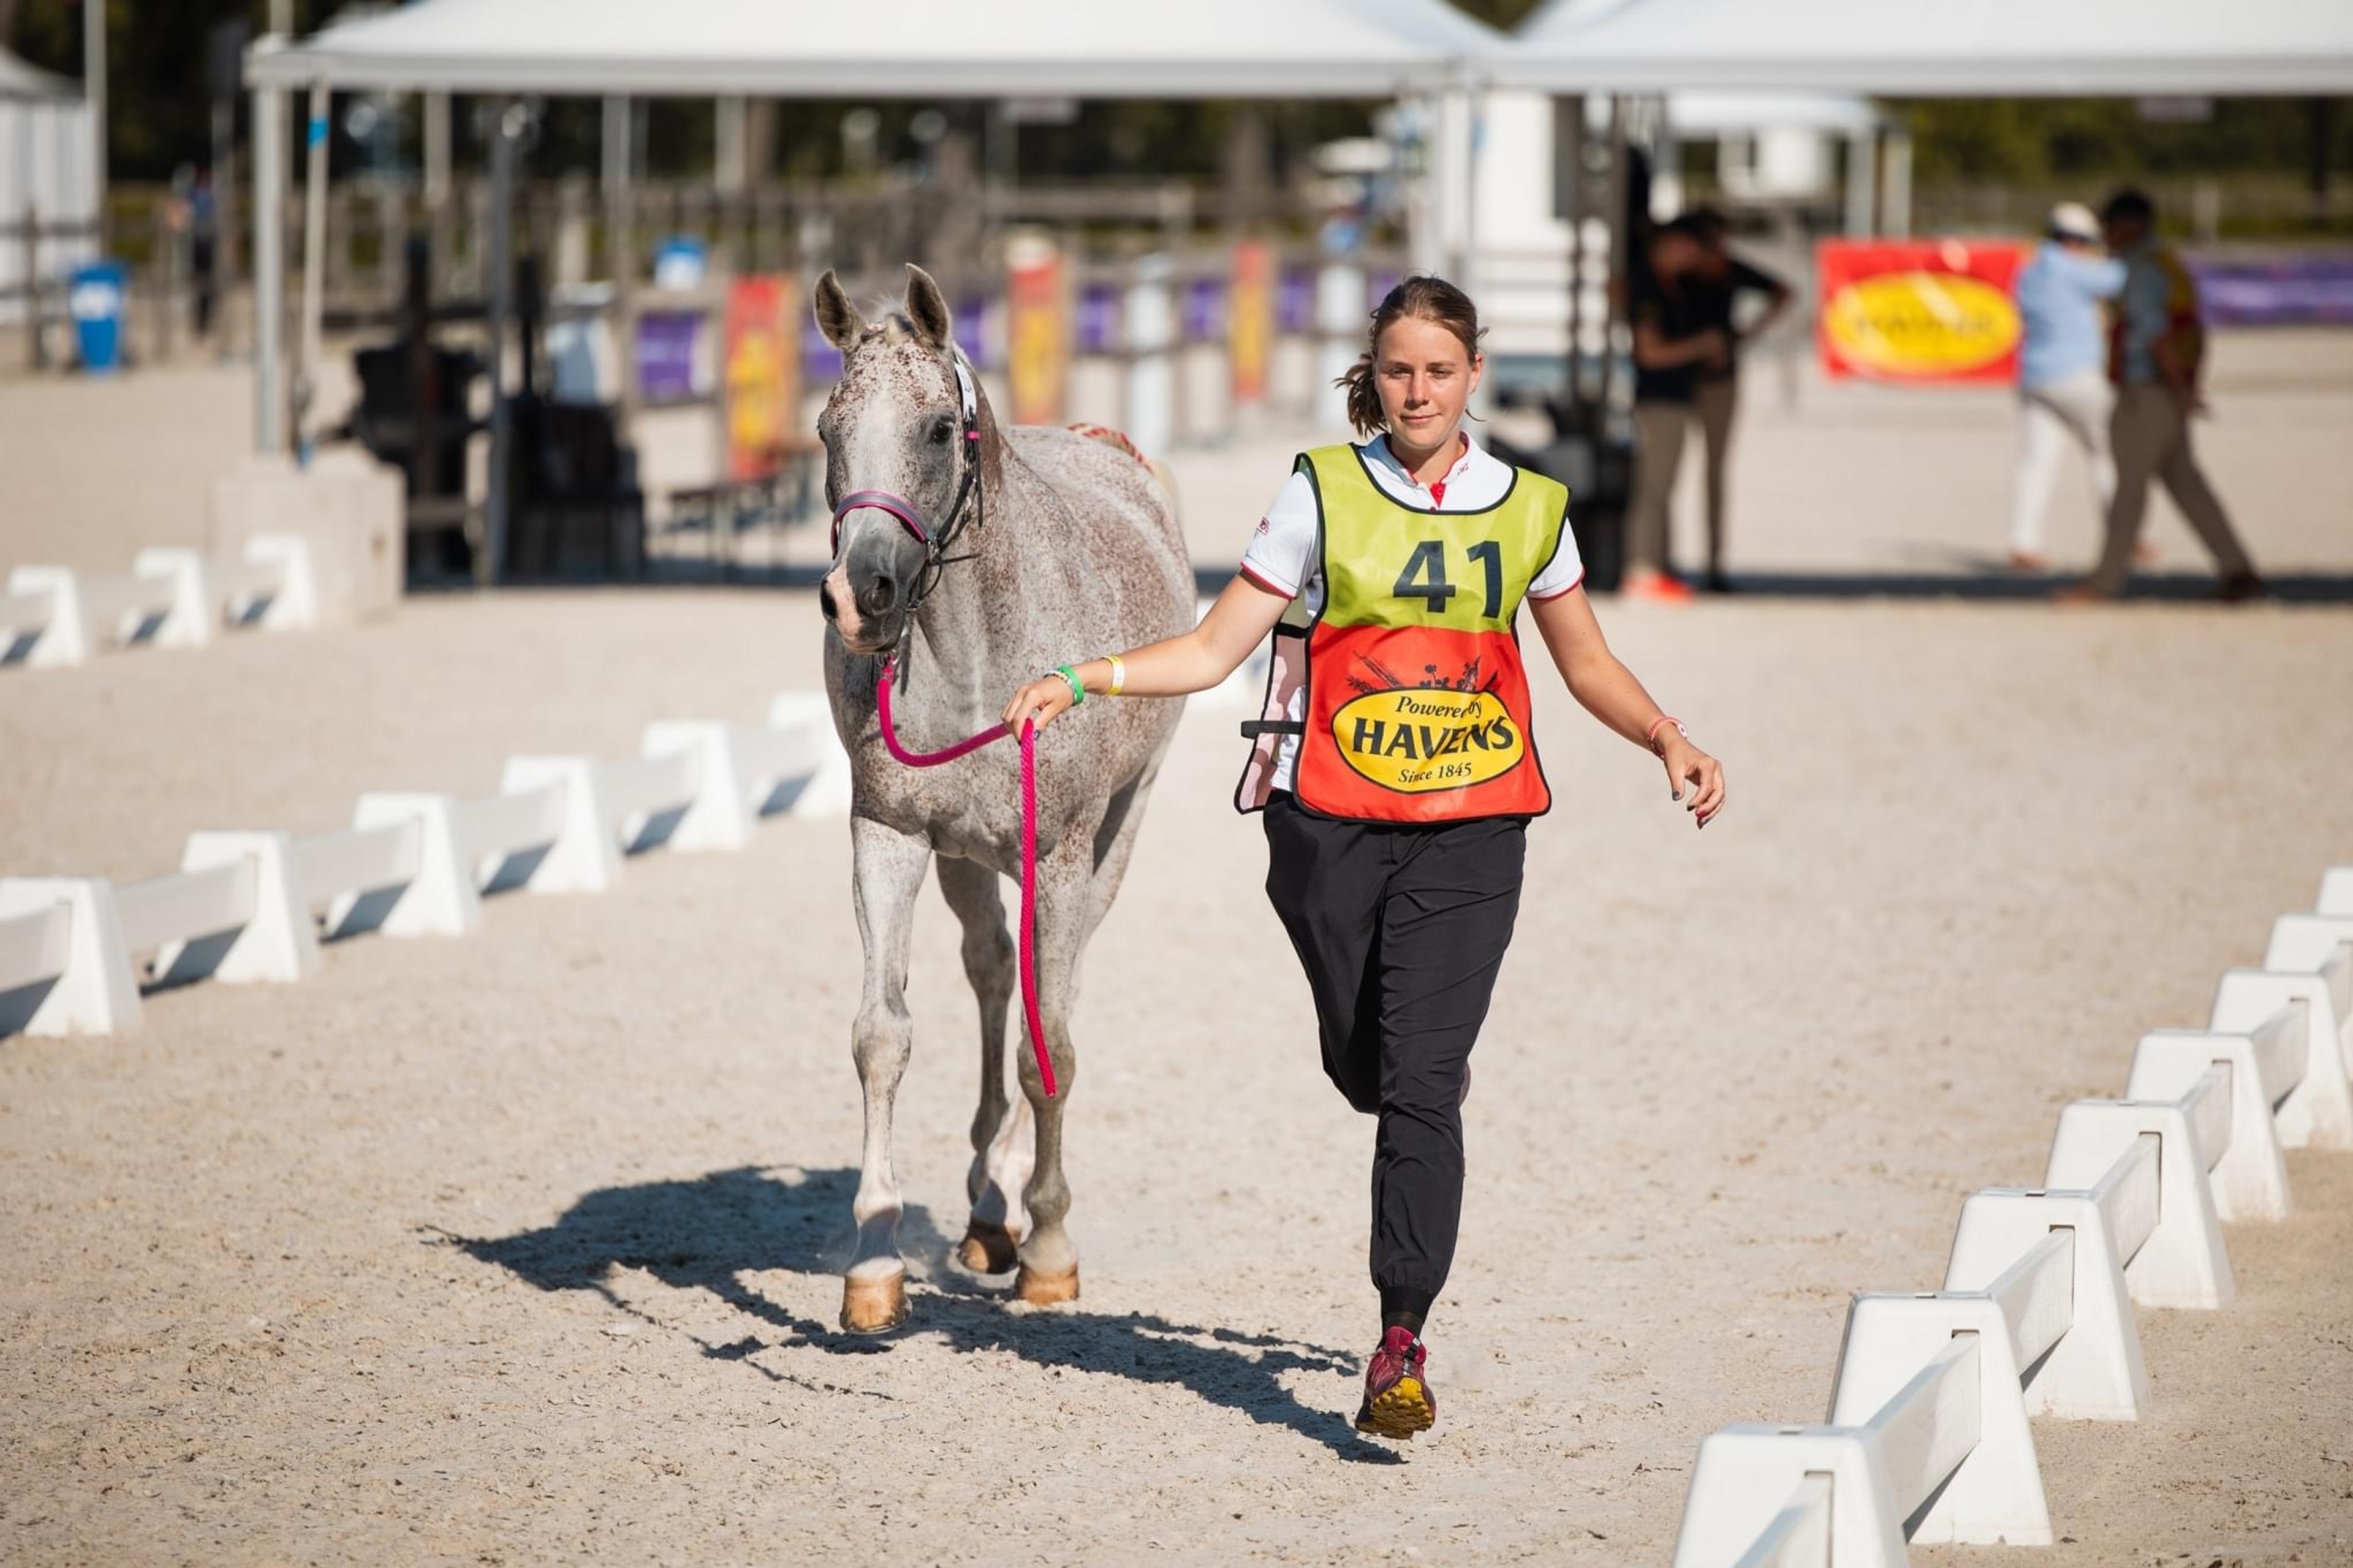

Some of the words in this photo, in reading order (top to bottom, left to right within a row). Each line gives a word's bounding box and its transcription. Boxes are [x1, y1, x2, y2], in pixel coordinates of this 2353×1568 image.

[1392, 540, 1504, 619] 41
[1353, 716, 1514, 760] HAVENS
[1398, 768, 1433, 783] Since
[1438, 762, 1472, 779] 1845
